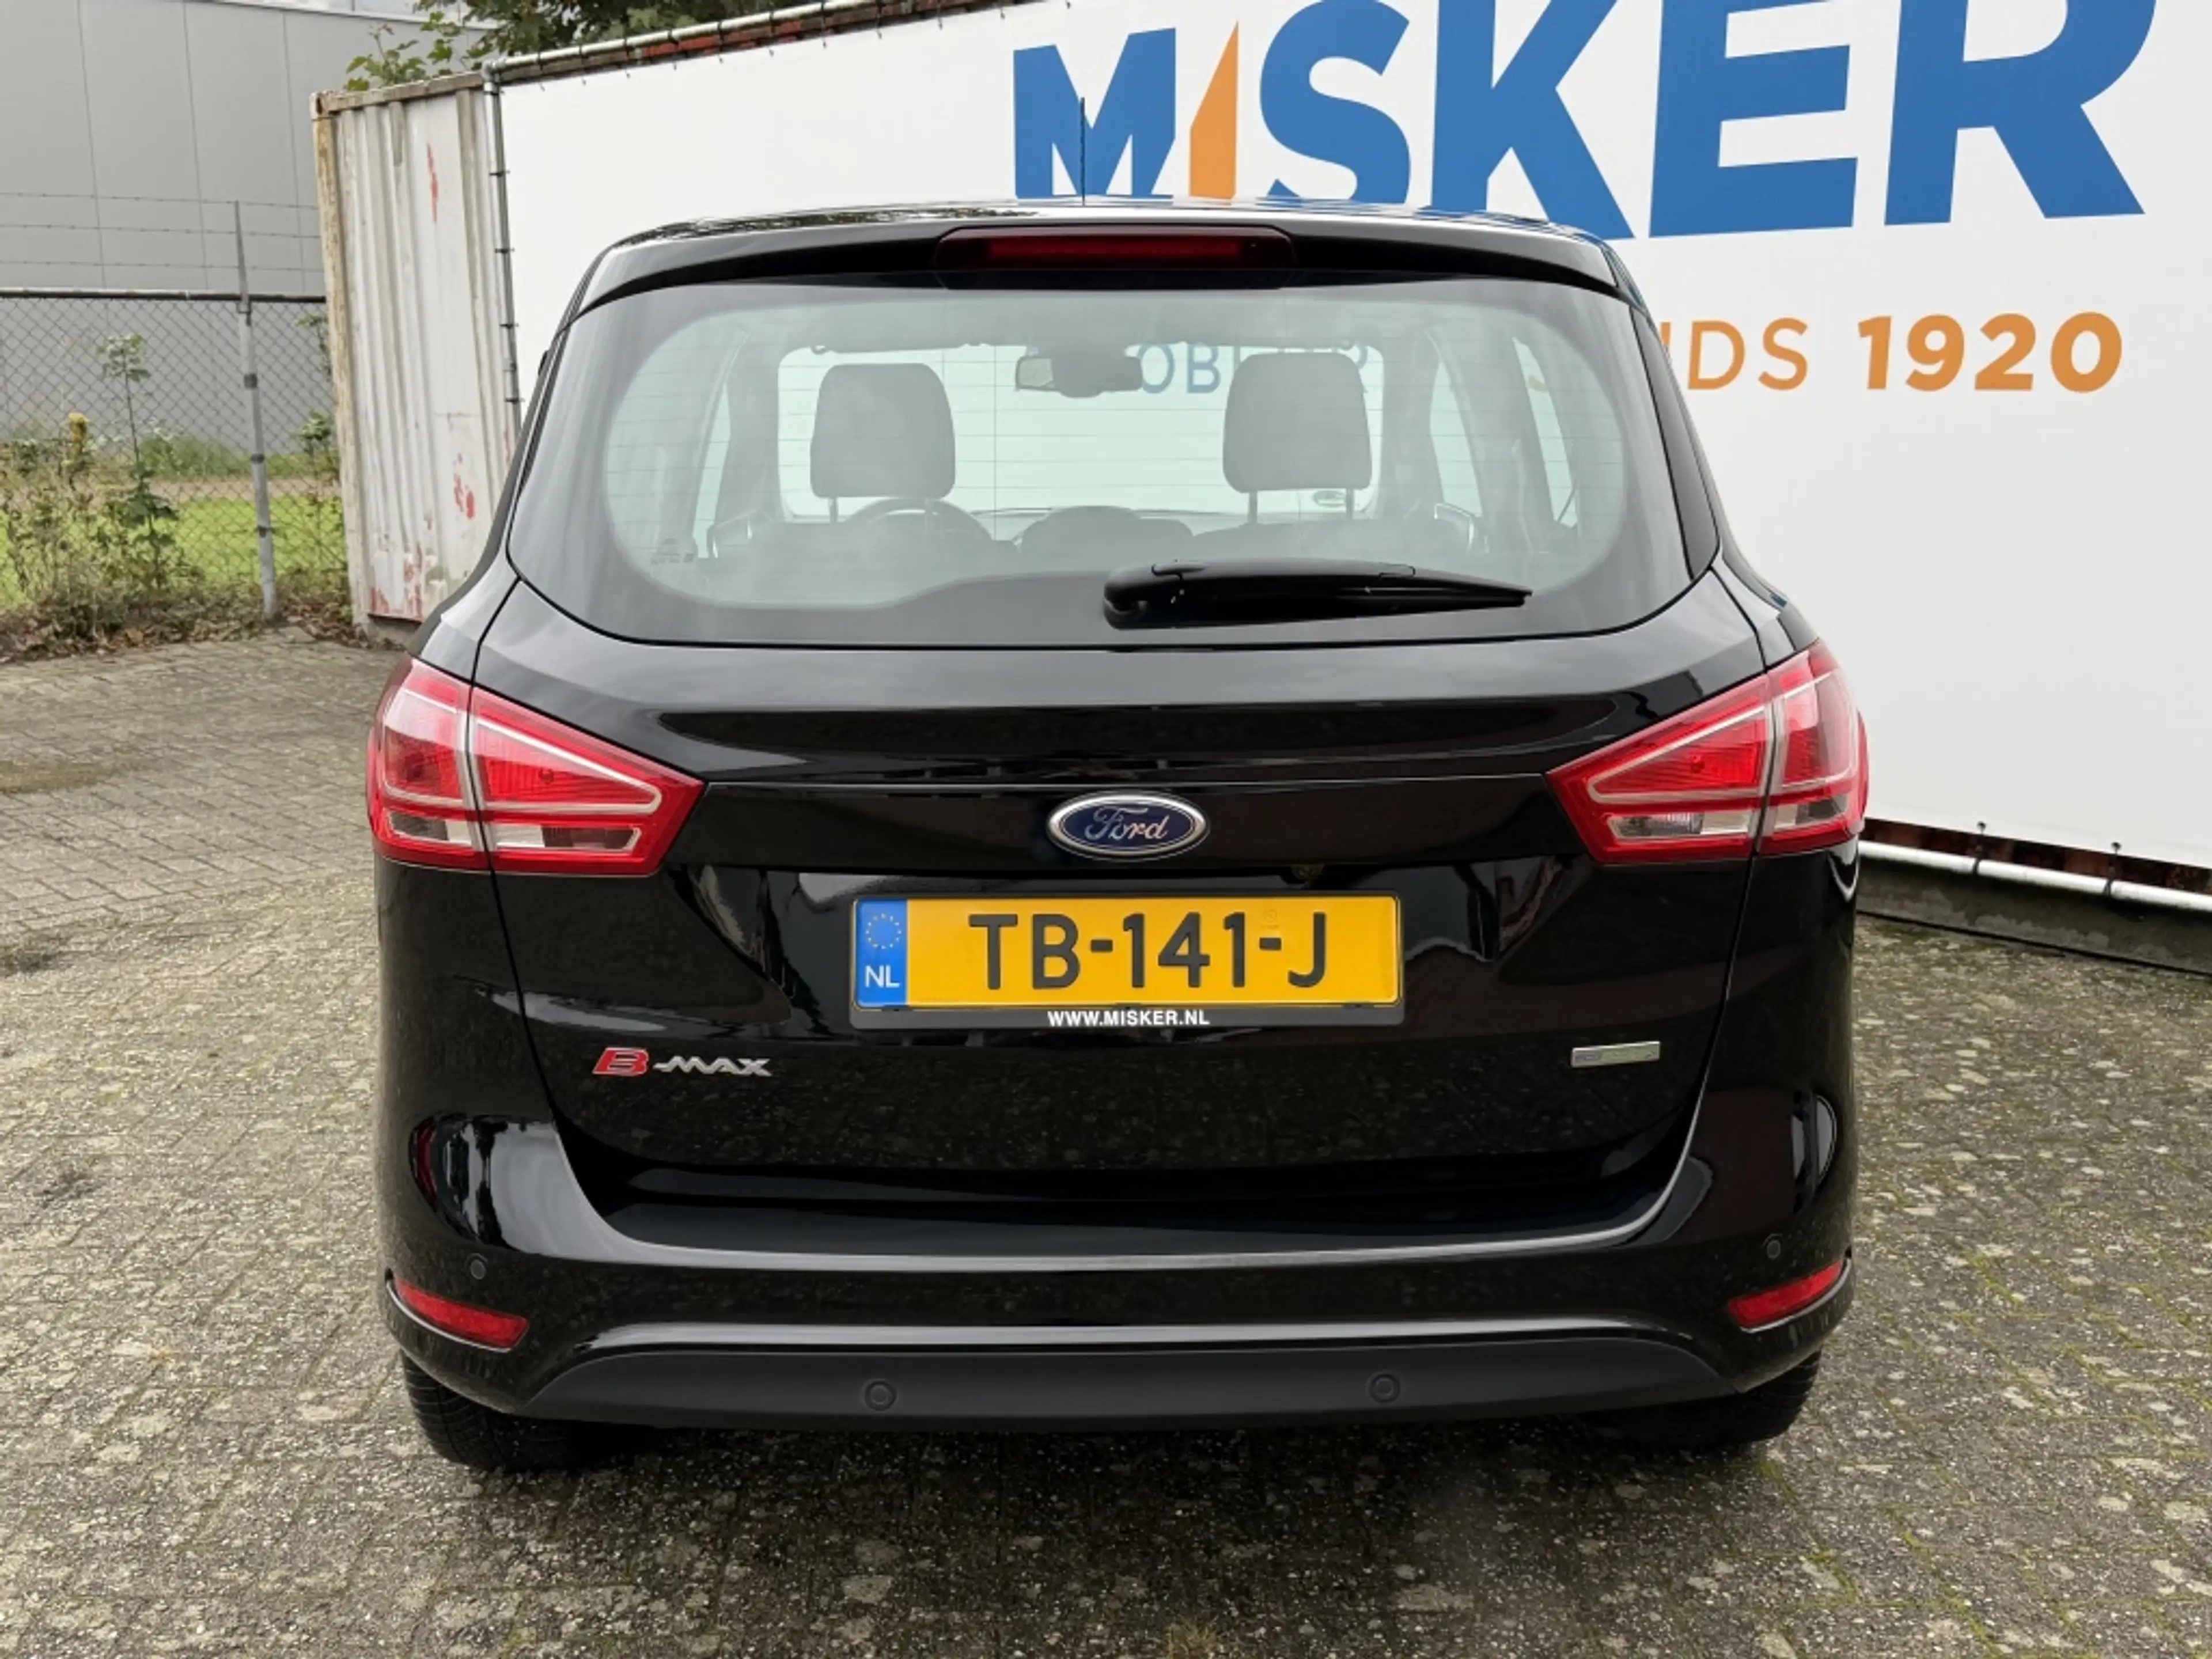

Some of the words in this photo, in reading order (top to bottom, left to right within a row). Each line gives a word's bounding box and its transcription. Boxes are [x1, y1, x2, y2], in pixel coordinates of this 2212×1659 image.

[1014, 0, 2156, 240] MISKER
[1660, 318, 1808, 391] DS
[1858, 312, 2123, 393] 1920
[1084, 805, 1170, 840] Ford
[864, 965, 900, 988] NL
[968, 912, 1327, 990] TB-141-J
[1047, 1009, 1211, 1027] WWW.MISKER.NL
